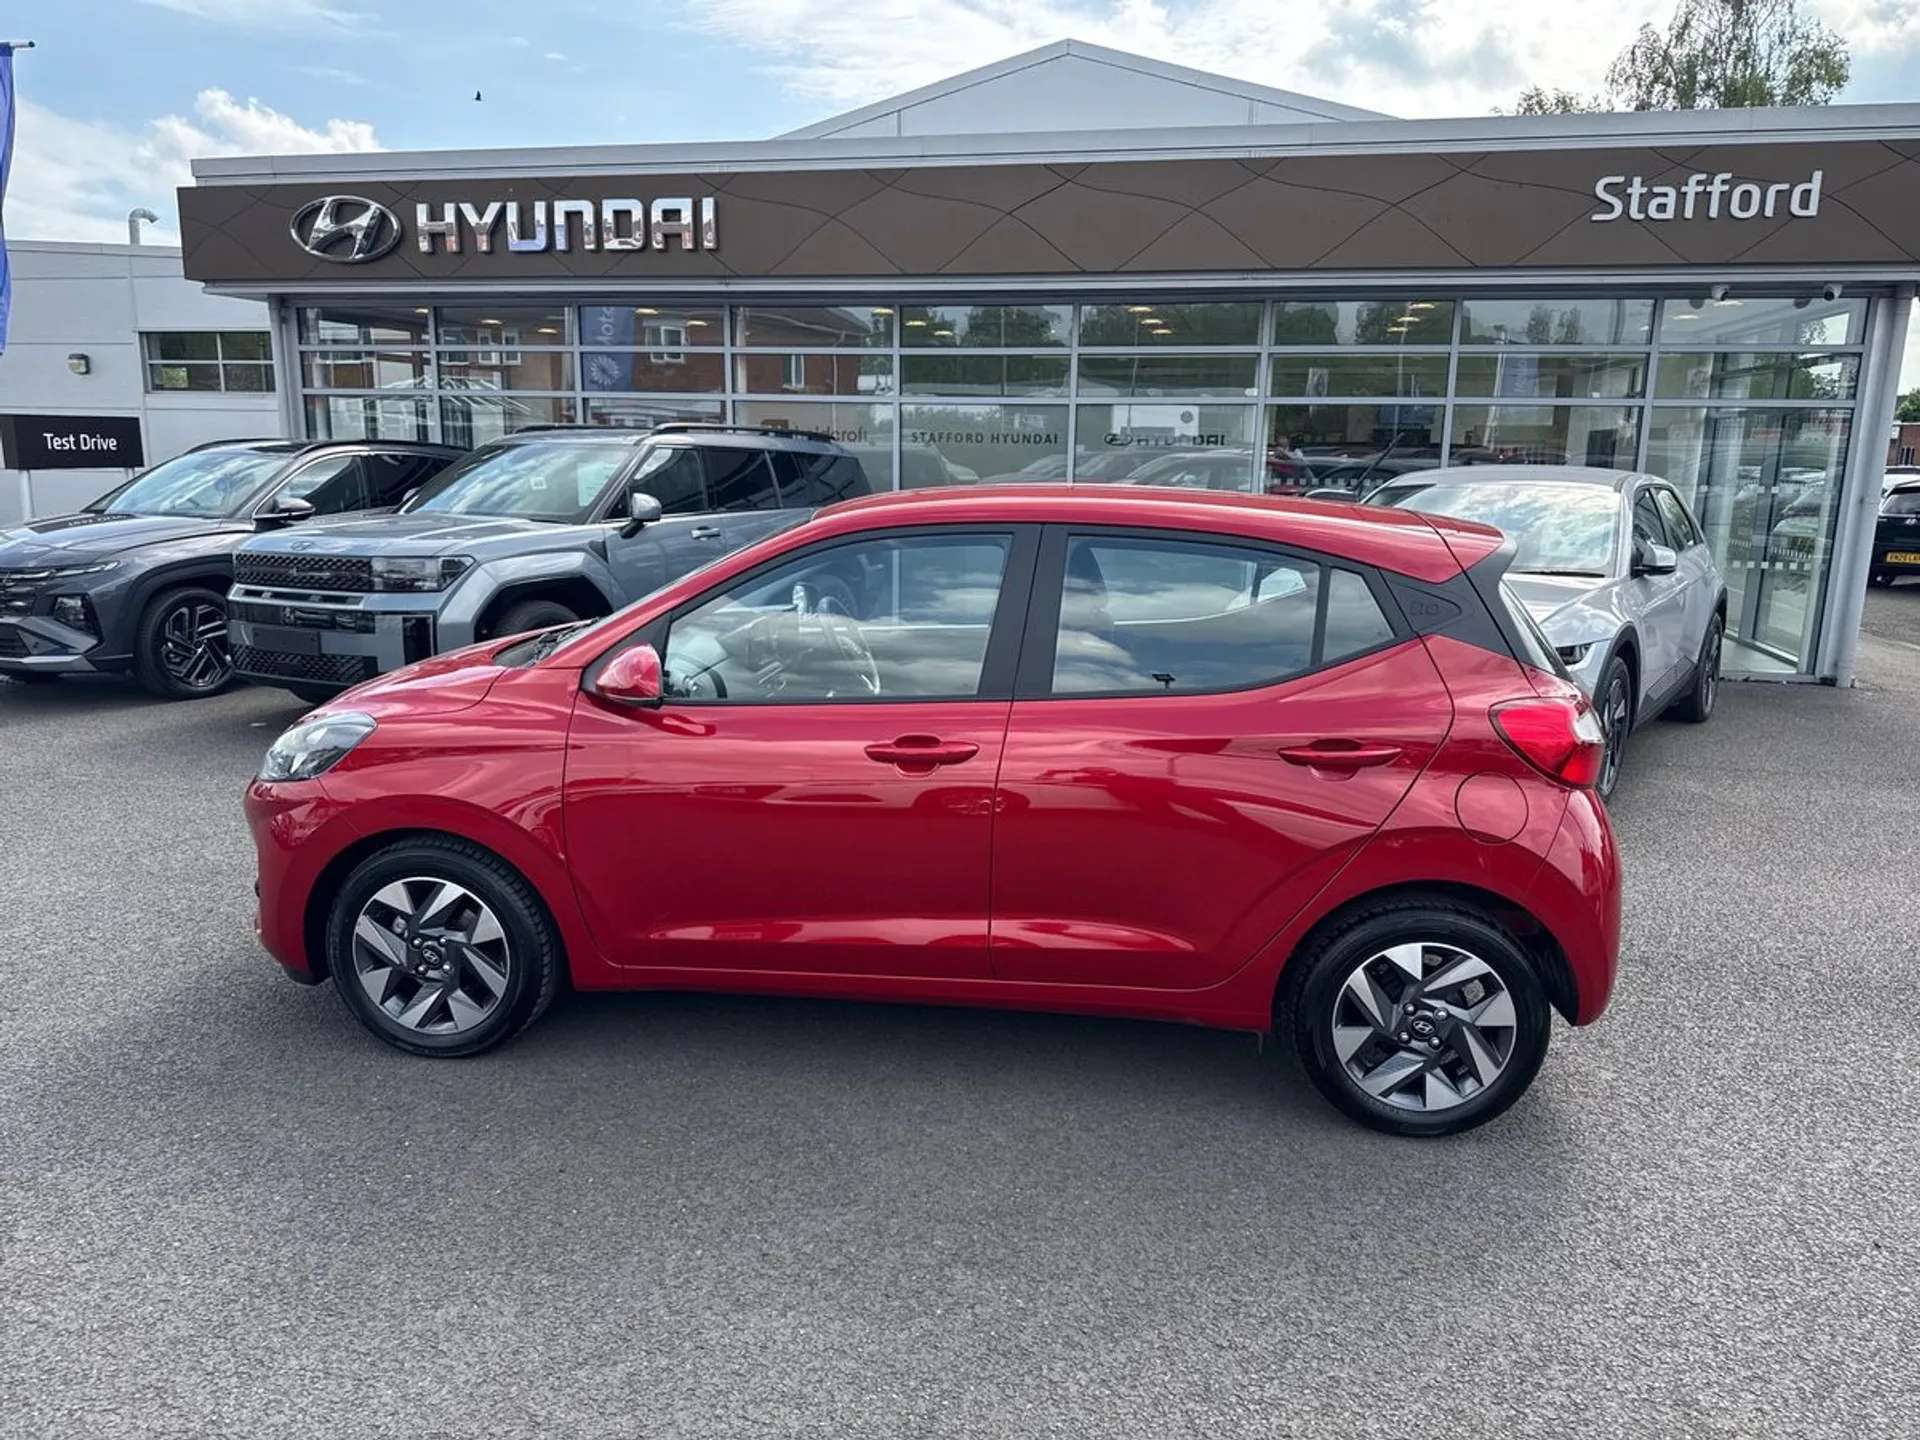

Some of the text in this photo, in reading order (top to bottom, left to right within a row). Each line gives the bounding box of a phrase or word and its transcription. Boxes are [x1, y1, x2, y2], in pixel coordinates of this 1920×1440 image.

[1591, 170, 1823, 221] Stafford
[415, 197, 718, 252] HYUNDAI
[43, 433, 117, 450] Test Drive
[911, 431, 1058, 444] STAFFORD HYUNDAI
